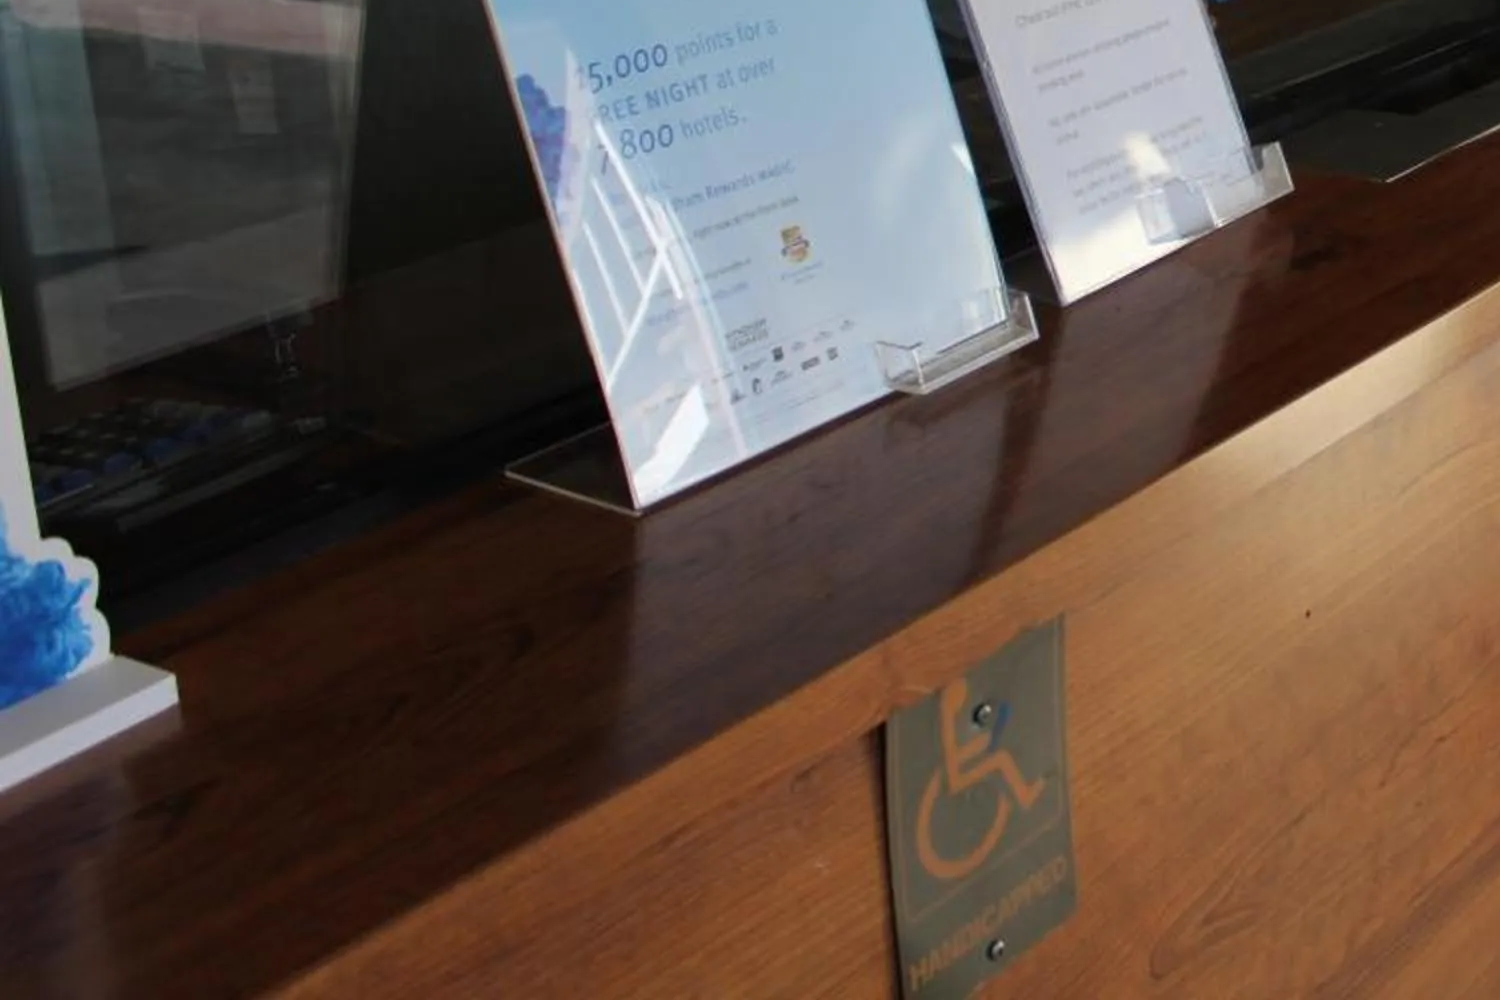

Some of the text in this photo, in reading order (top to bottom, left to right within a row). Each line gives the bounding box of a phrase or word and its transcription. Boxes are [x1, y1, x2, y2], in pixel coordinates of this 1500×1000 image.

[674, 30, 734, 66] points
[736, 21, 760, 42] for
[765, 19, 778, 35] a
[597, 57, 775, 125] REE NIGHT at over
